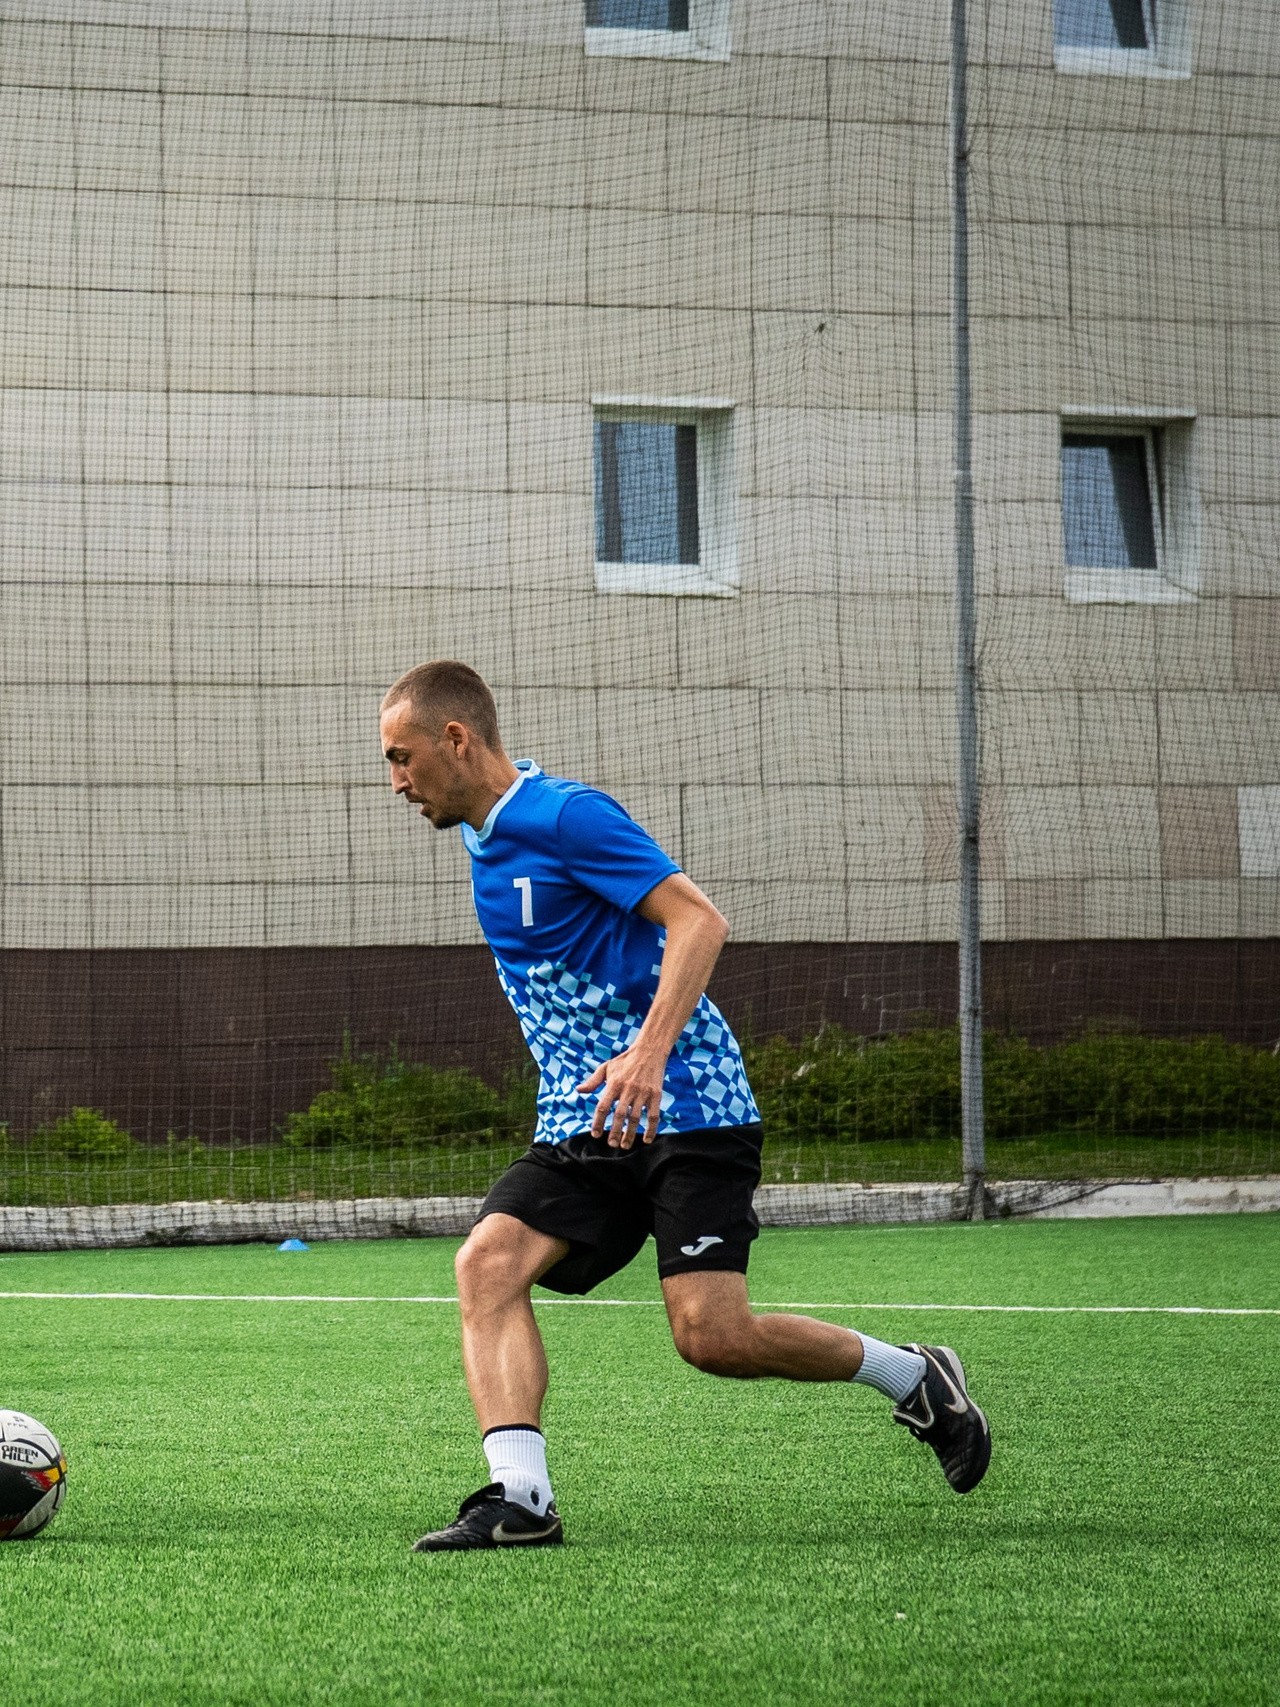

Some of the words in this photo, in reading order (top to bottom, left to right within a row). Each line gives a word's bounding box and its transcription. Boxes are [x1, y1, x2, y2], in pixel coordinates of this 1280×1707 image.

[513, 876, 534, 927] 1
[1, 1445, 38, 1457] GREEN
[2, 1450, 33, 1464] HILL
